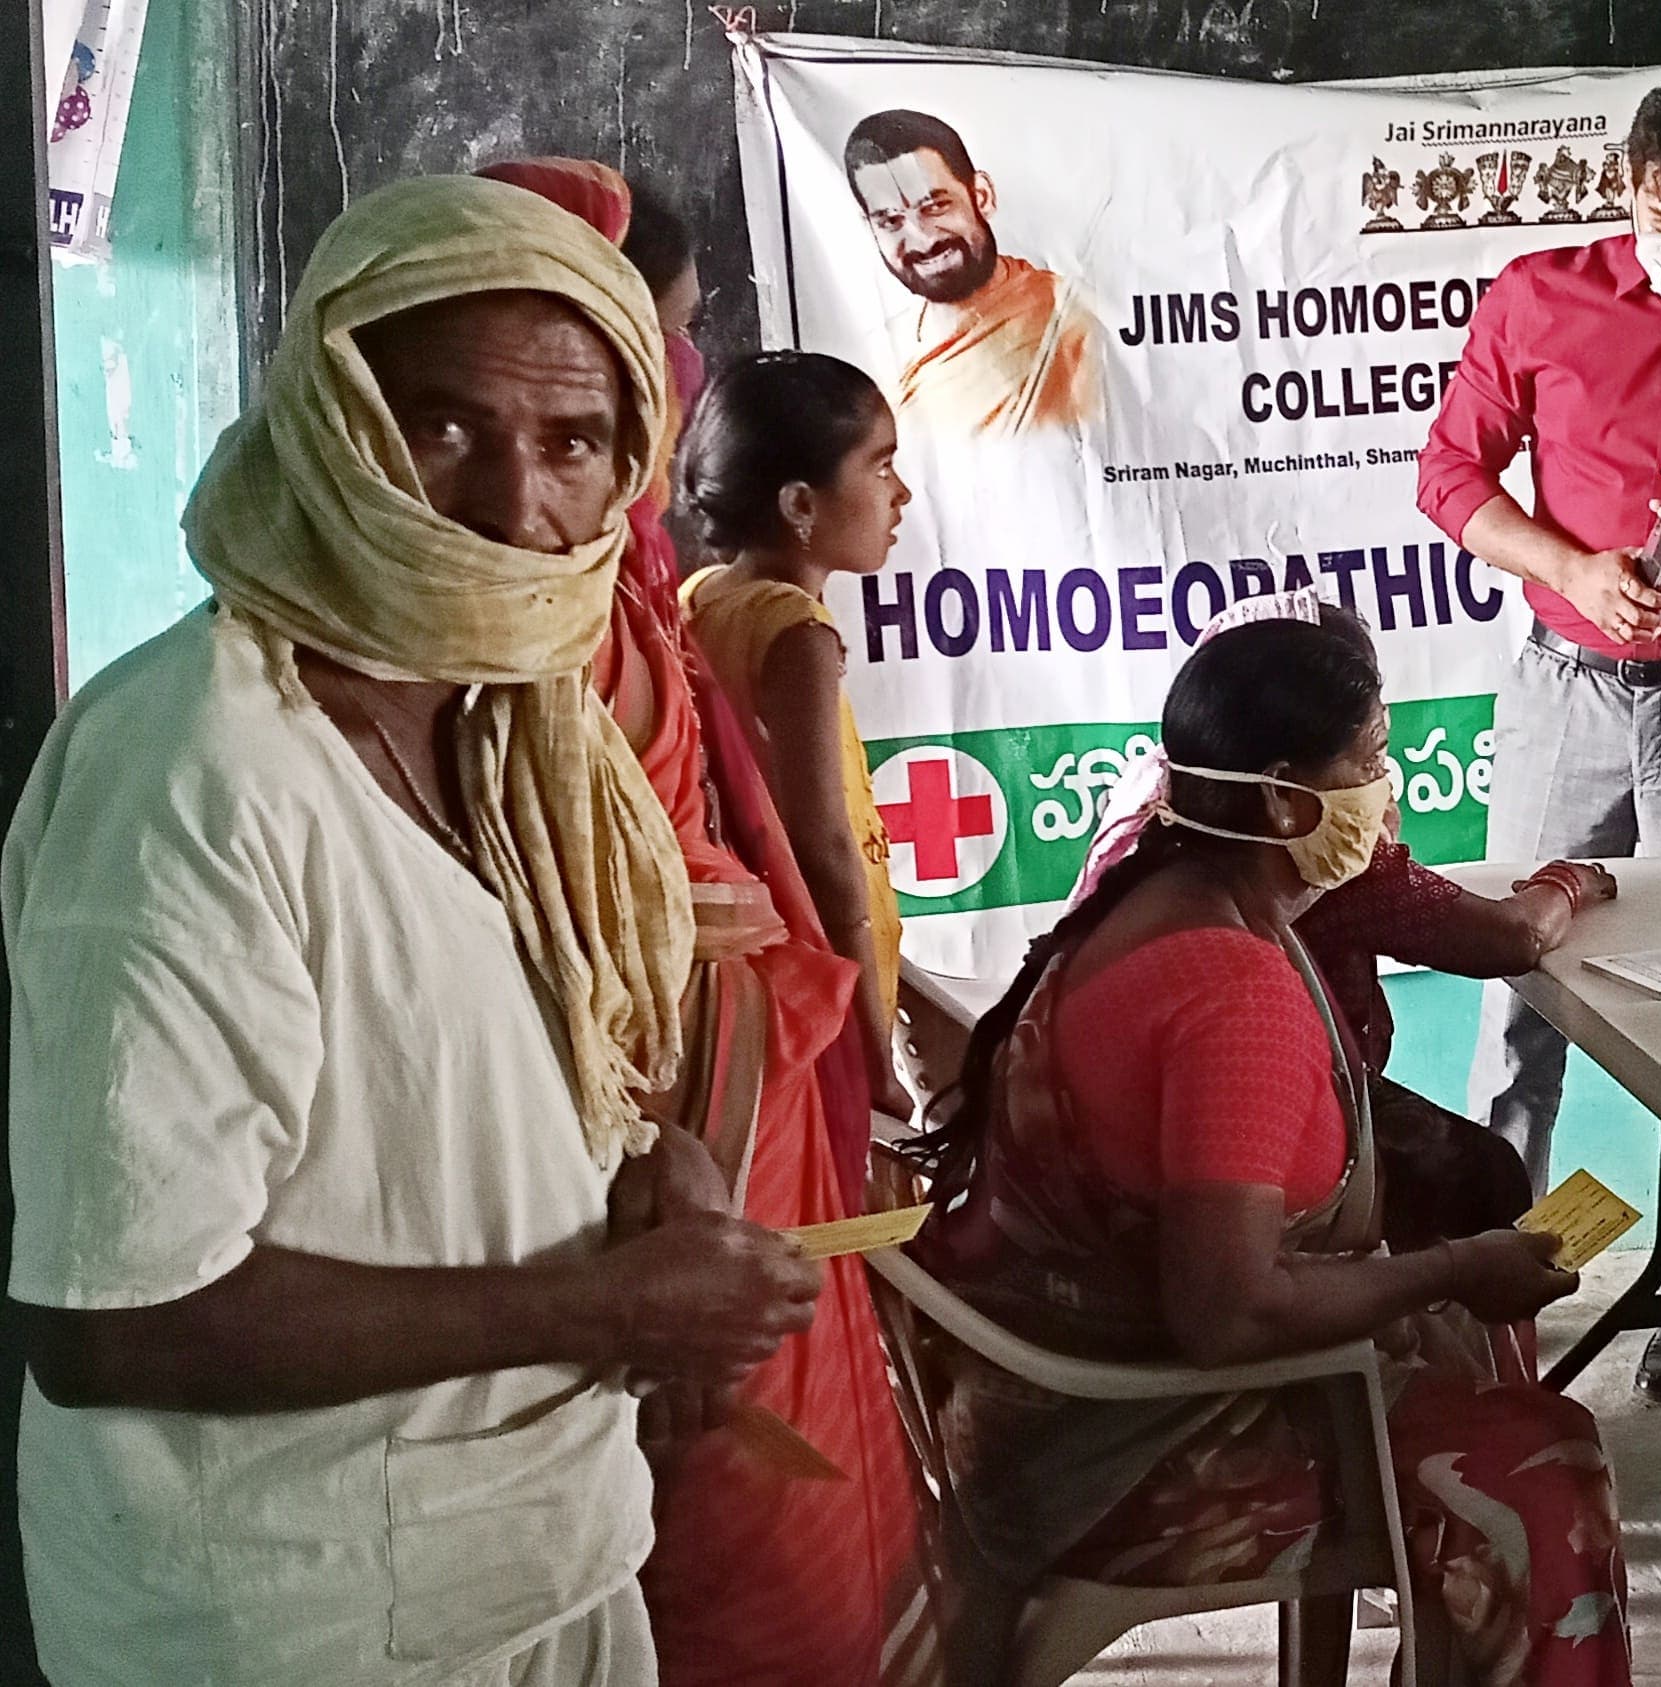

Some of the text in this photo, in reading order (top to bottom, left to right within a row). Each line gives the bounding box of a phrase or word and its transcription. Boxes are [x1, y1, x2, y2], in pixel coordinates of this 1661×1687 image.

[1385, 113, 1607, 142] Jai Srimannarayana
[1119, 291, 1241, 346] JIMS
[1103, 465, 1169, 483] Sriram
[1175, 461, 1238, 480] Nagar,
[1244, 450, 1360, 475] Muchinthal,
[1366, 448, 1420, 465] Sham
